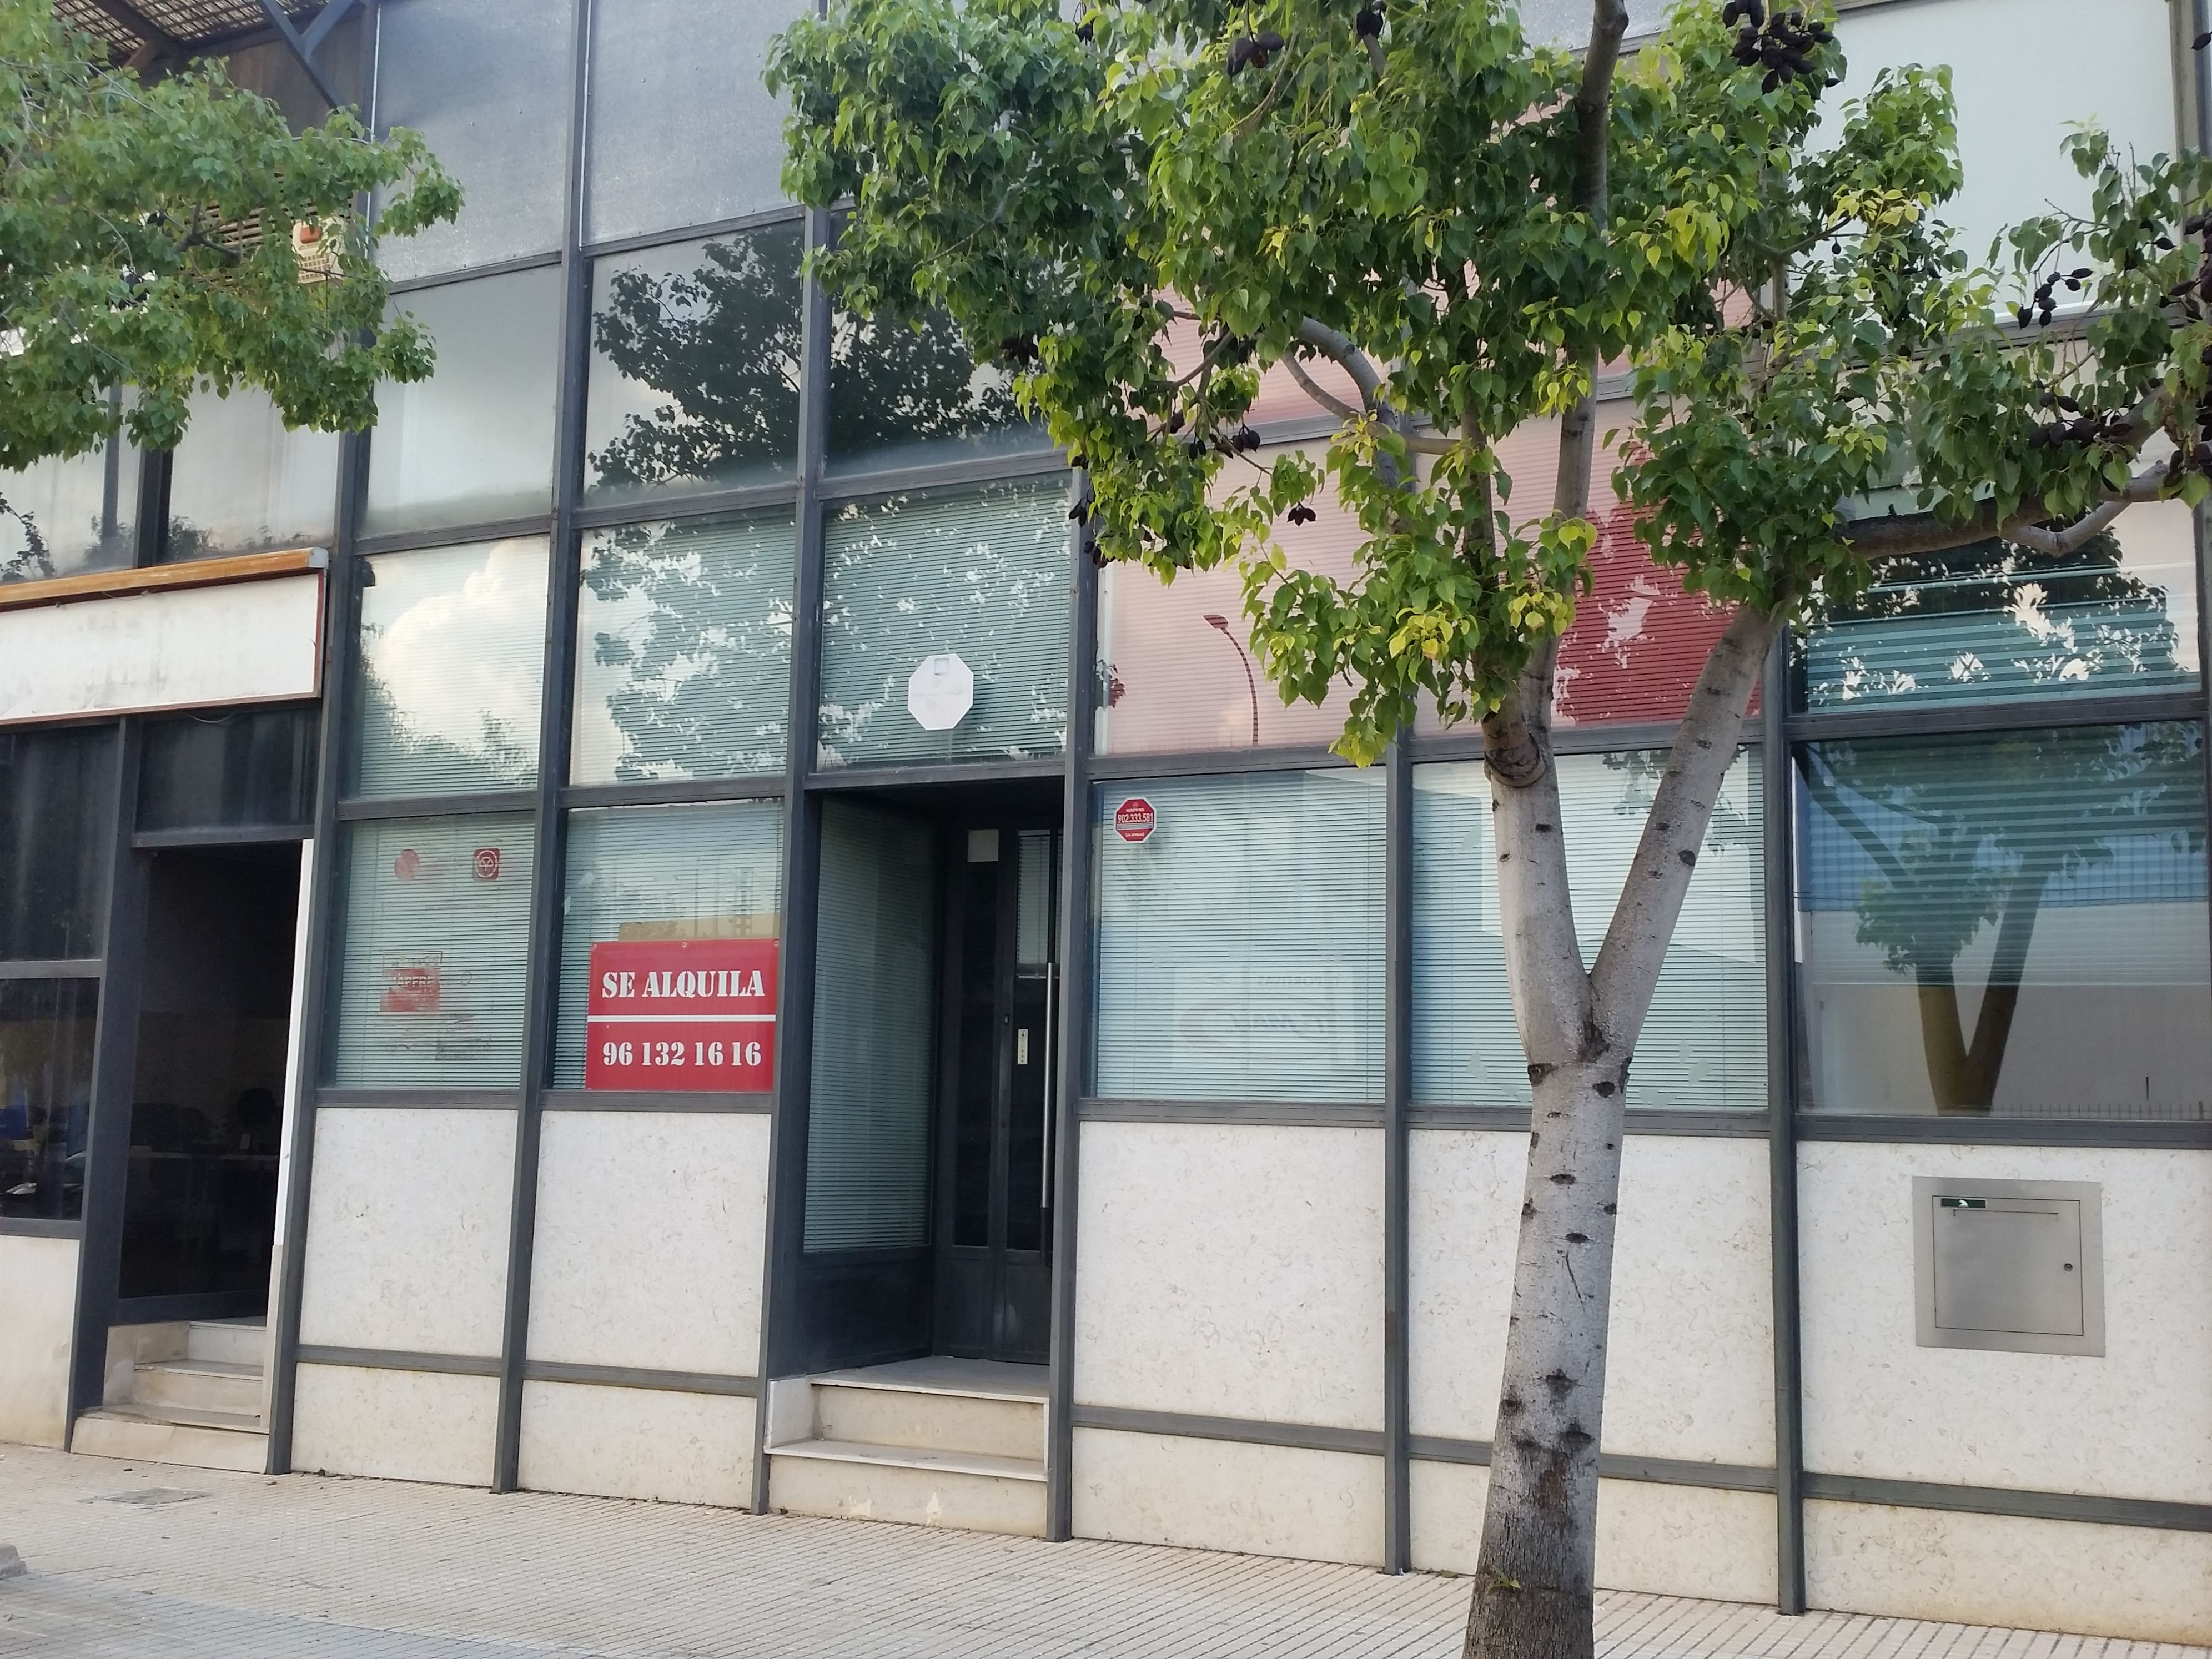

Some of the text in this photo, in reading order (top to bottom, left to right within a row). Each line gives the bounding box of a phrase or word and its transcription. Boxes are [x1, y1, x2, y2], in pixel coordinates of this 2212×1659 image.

[1117, 813, 1153, 823] 902.333.581
[602, 969, 765, 998] SE ALQUILA
[602, 1042, 761, 1066] 96 132 16 16
